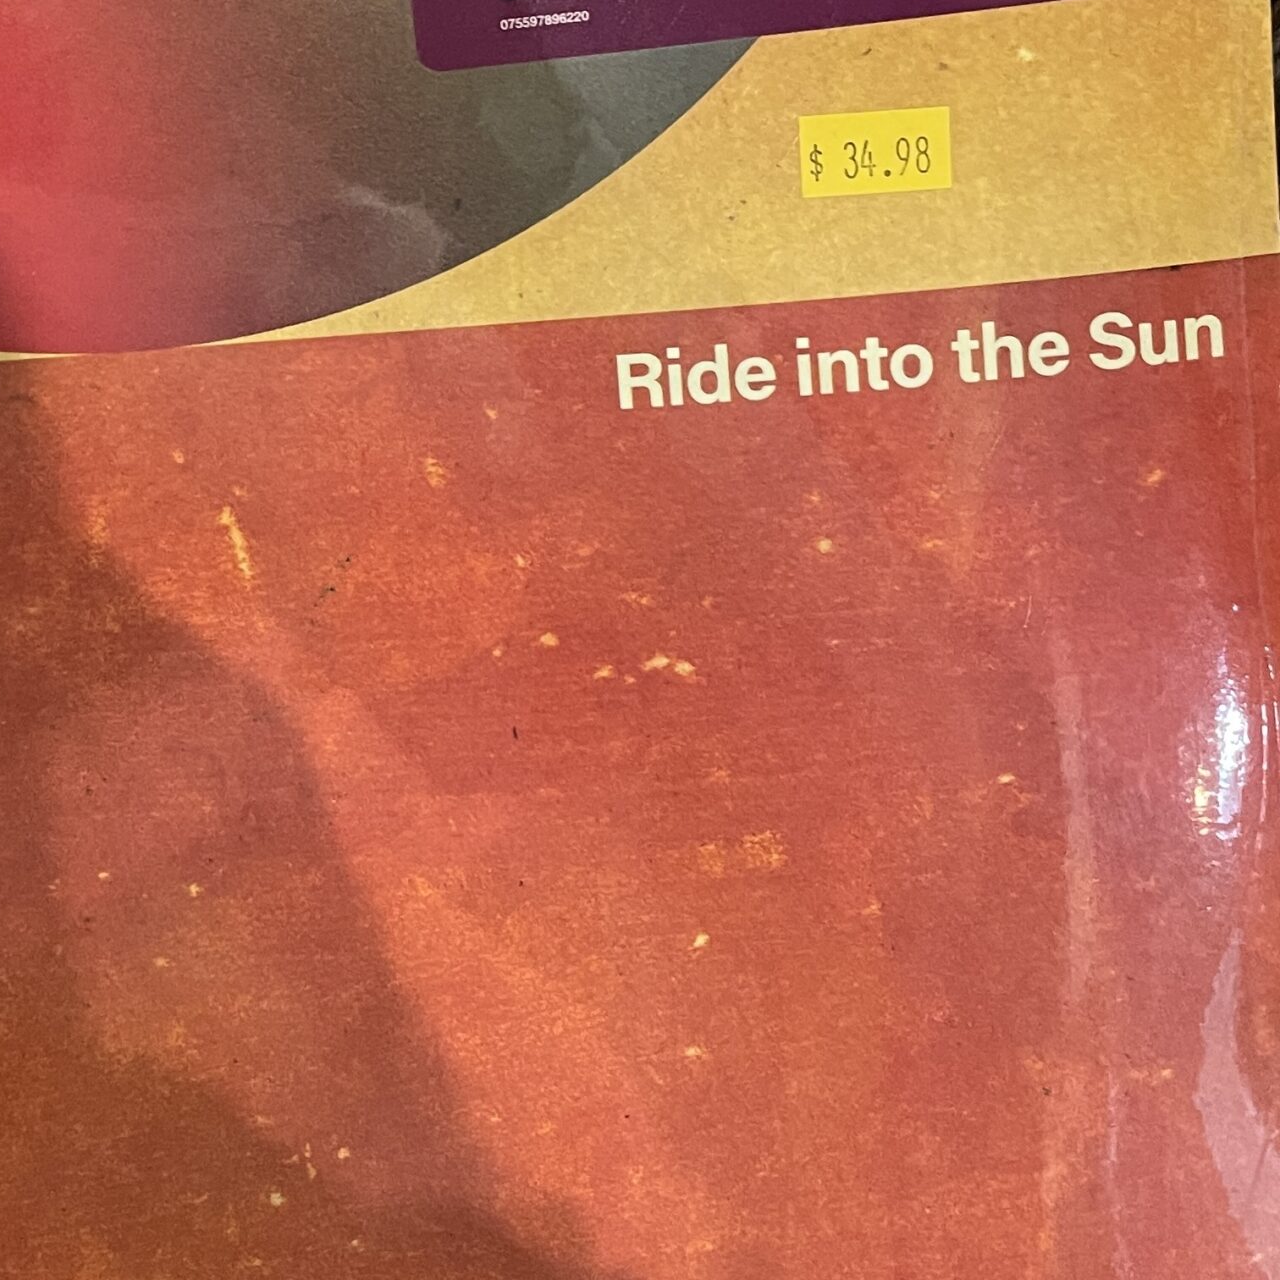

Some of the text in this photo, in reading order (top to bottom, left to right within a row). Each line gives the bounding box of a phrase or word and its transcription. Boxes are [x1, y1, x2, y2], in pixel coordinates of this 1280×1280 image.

[500, 10, 590, 31] 075597896220
[809, 136, 932, 182] $ 34.98
[615, 311, 1225, 410] Ride into the Sun
